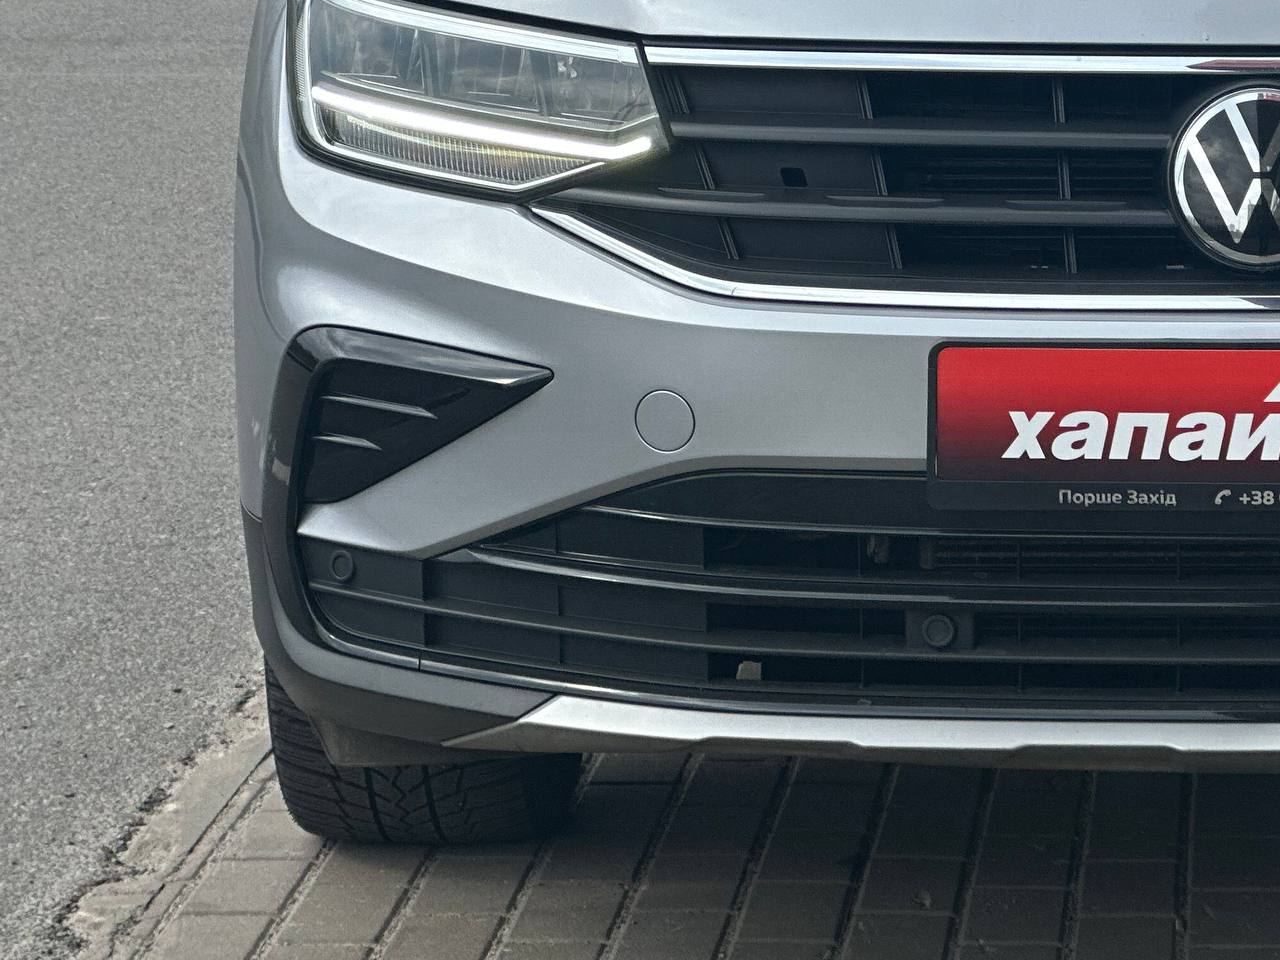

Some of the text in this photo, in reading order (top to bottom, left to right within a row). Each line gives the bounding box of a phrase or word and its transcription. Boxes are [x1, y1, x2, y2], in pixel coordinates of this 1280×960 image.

[1058, 489, 1177, 507] Порше Захід
[1239, 490, 1274, 505] +38
